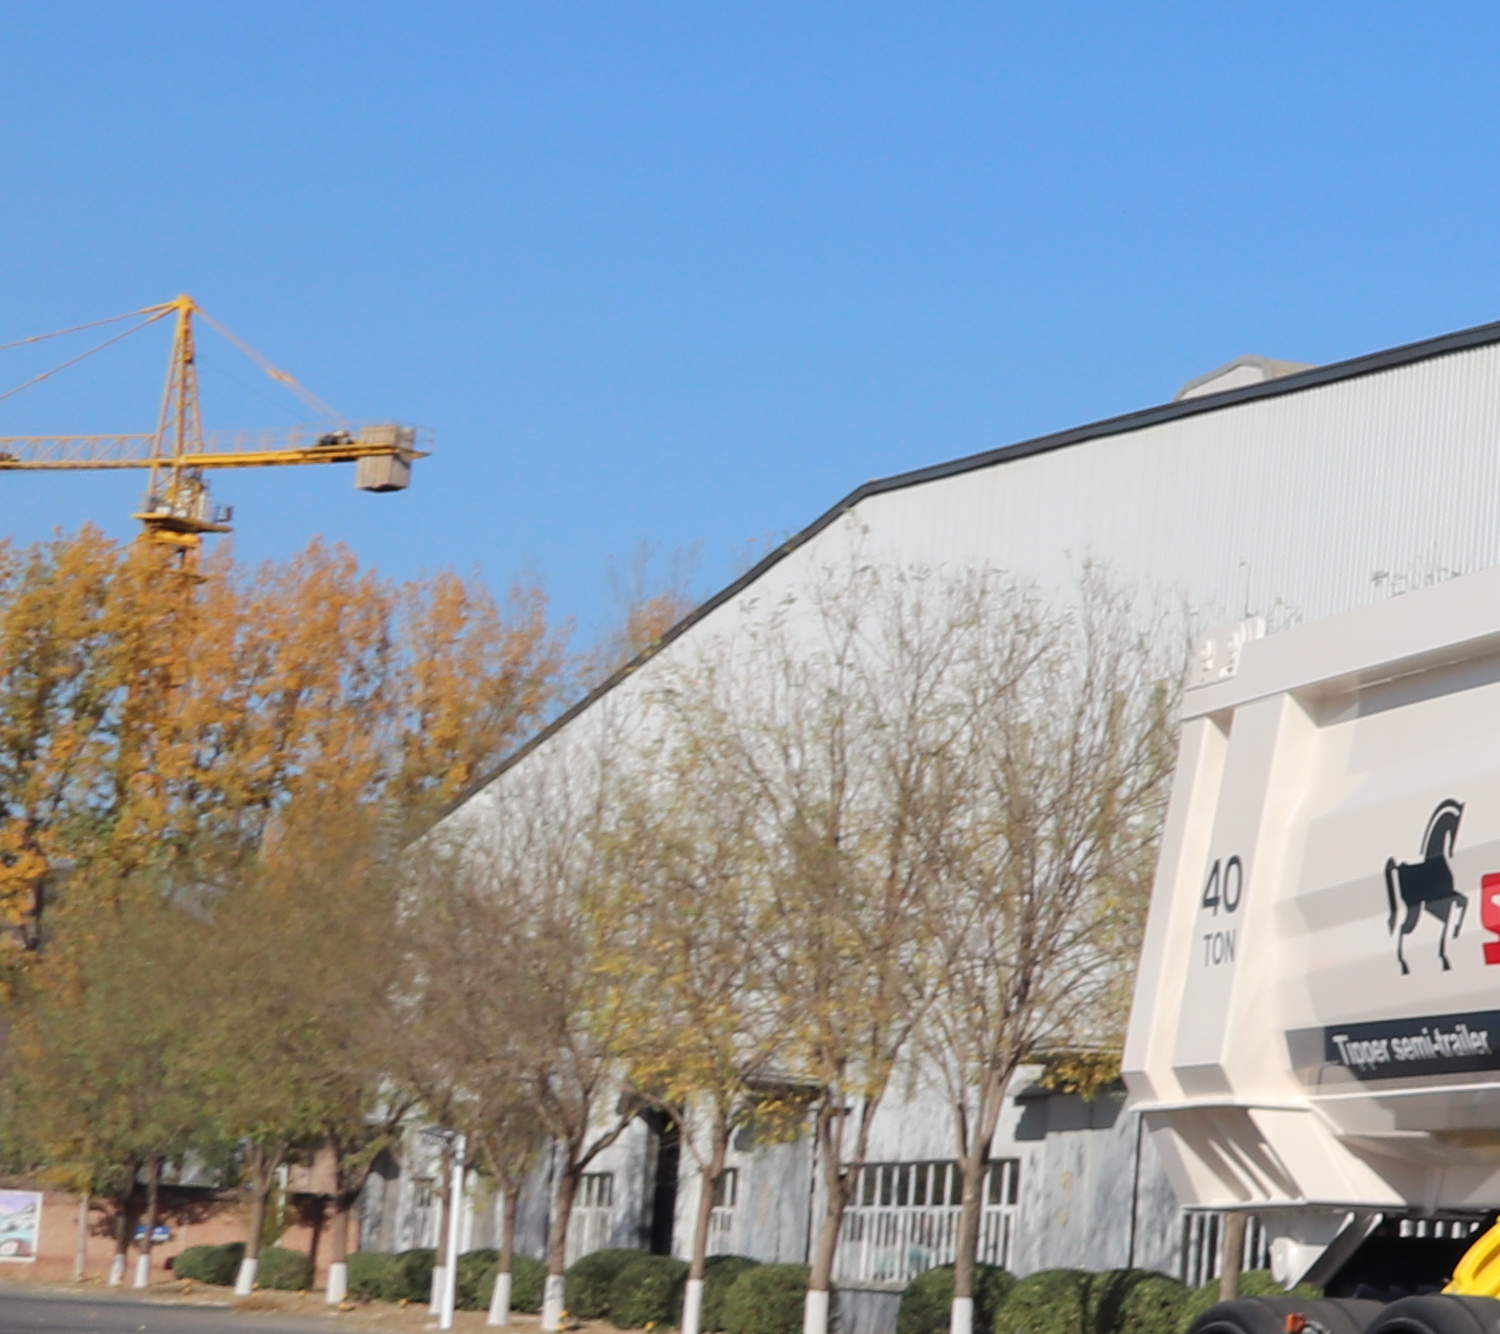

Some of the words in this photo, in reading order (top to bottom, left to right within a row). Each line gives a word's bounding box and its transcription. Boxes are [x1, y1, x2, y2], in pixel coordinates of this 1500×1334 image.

[1201, 854, 1243, 917] 40
[1203, 929, 1237, 968] TON
[1331, 1034, 1391, 1071] Tipper
[1391, 1023, 1492, 1062] semi-trailer
